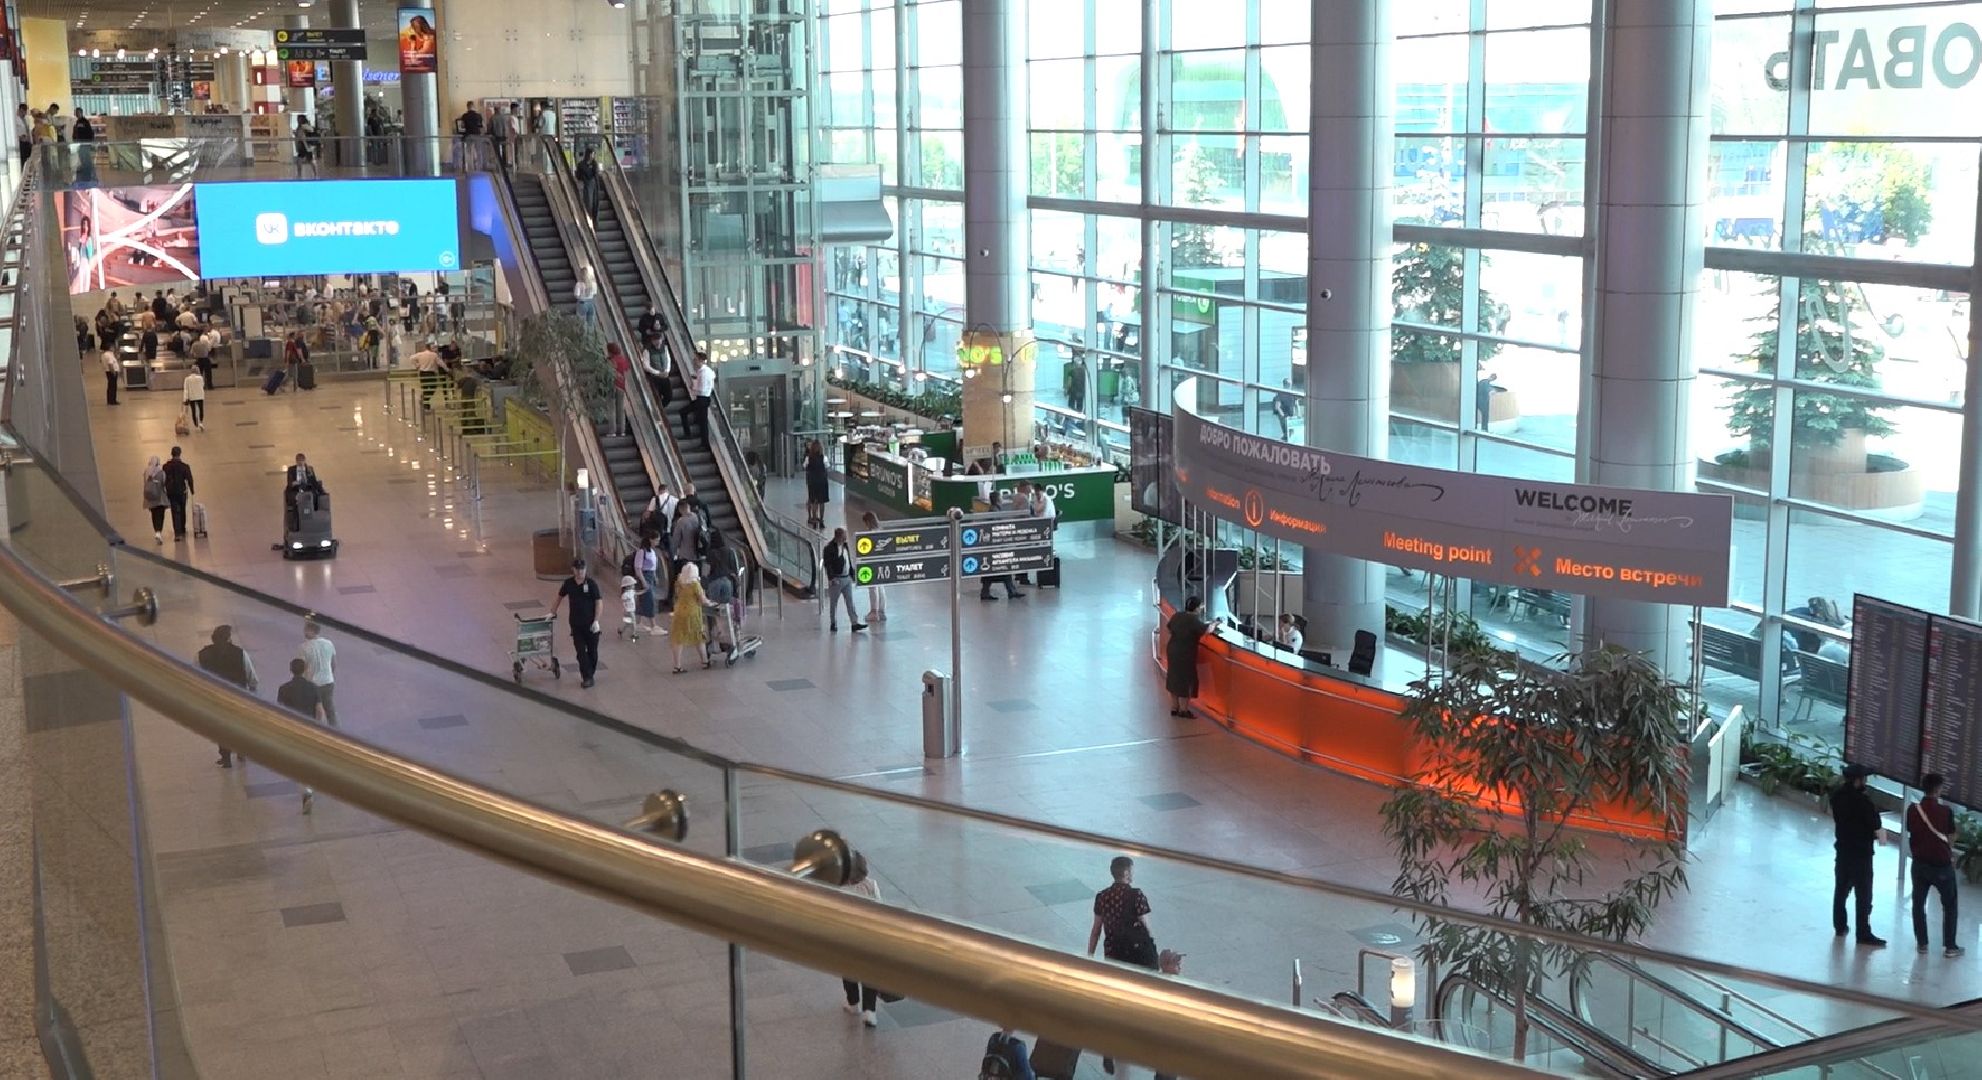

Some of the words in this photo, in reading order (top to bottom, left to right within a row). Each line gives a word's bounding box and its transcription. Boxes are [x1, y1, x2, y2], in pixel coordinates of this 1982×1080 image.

[1200, 424, 1230, 449] ДОБРО
[1232, 435, 1331, 475] ПОЖАЛОВАТЬ
[1515, 489, 1633, 518] WELCOME
[1383, 531, 1443, 560] Meeting
[1449, 545, 1493, 565] point
[1555, 558, 1615, 580] Место
